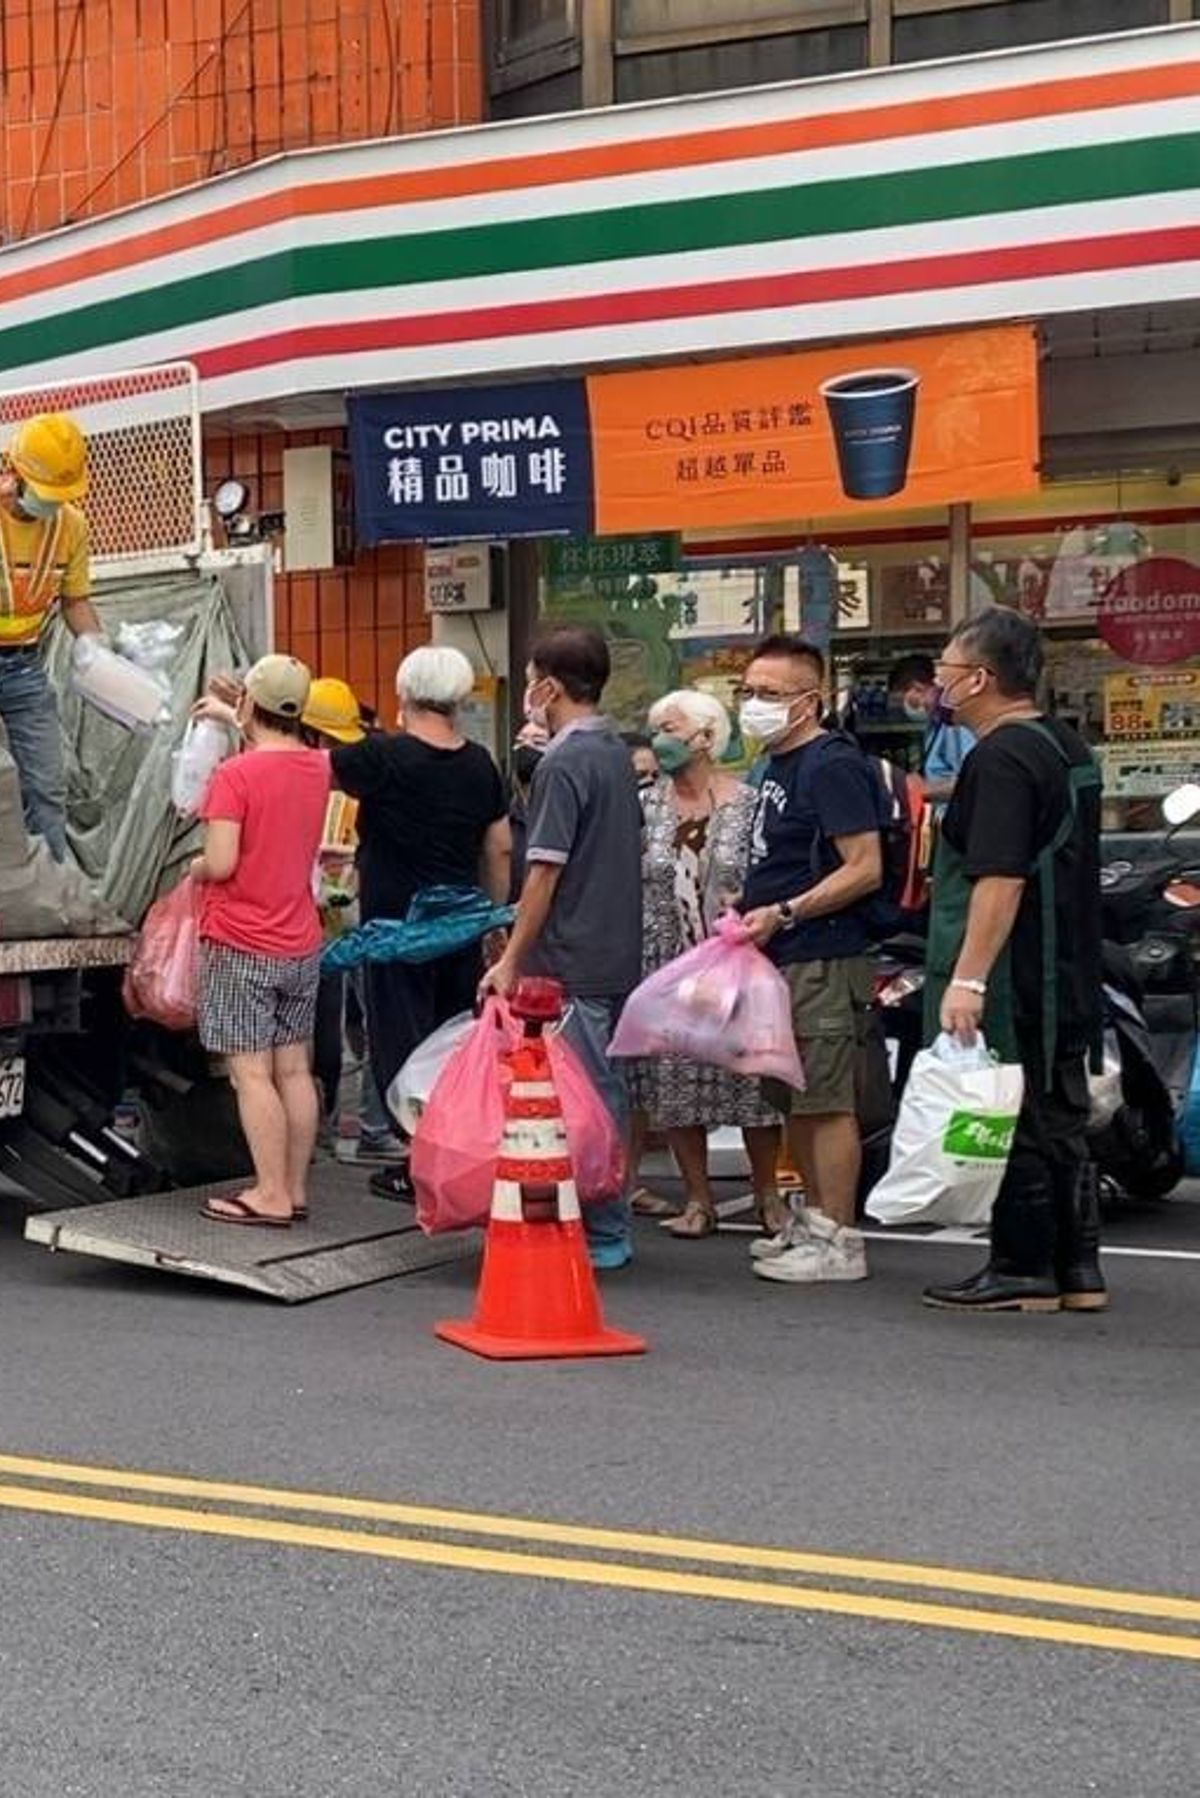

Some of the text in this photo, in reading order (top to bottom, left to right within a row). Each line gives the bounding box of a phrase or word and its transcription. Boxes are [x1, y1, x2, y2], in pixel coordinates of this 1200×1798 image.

[383, 415, 561, 450] CITY PRIMA
[387, 447, 567, 505] 精品咖啡
[676, 449, 786, 482] 超越單品
